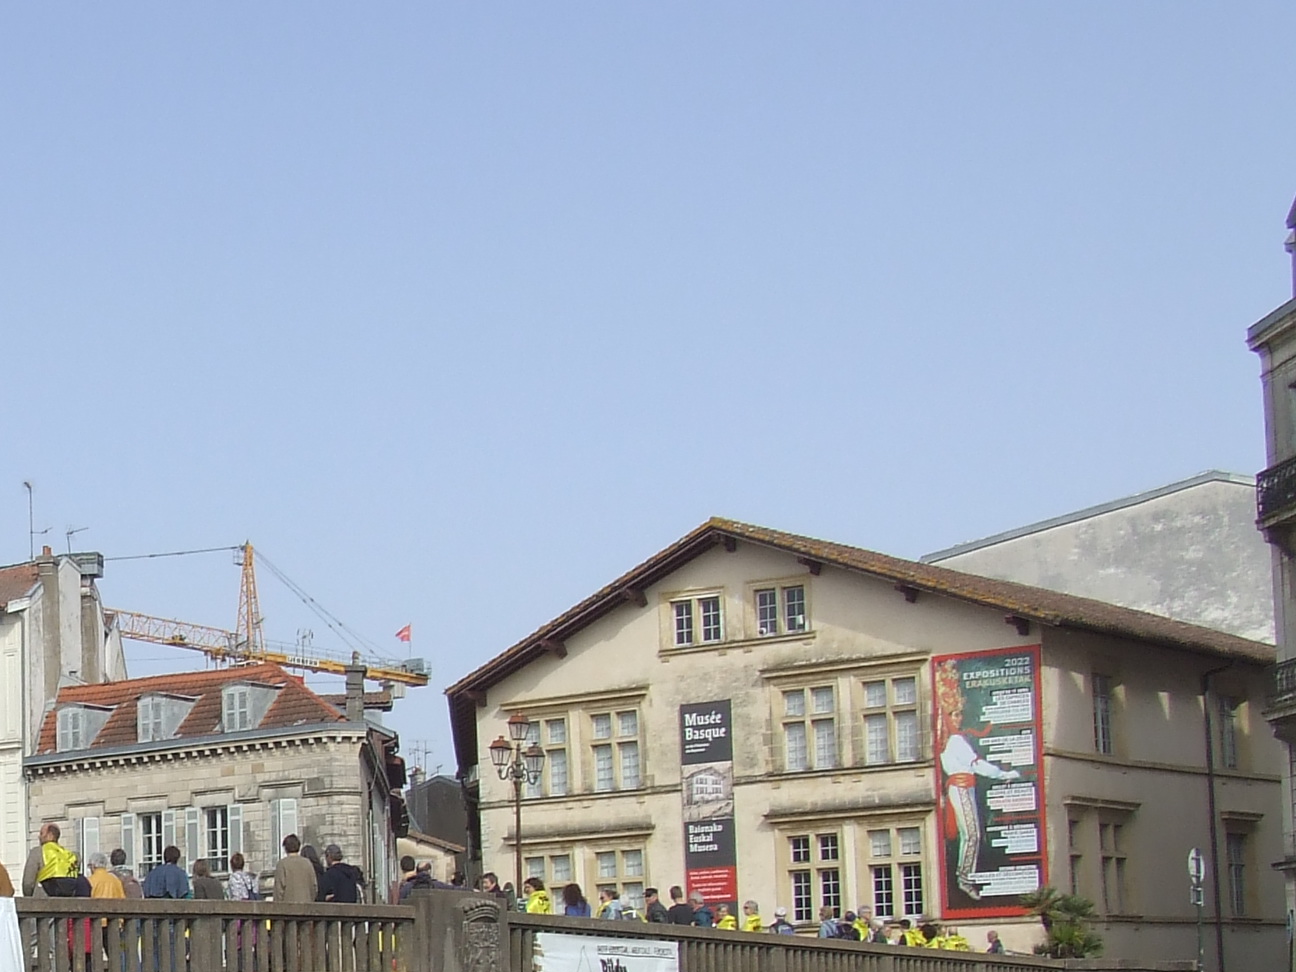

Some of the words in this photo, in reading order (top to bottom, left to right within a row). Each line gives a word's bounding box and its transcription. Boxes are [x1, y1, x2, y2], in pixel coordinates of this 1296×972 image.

[1004, 656, 1031, 668] 2022
[962, 665, 1032, 681] EXPOSITIONS
[965, 674, 1032, 689] ERAKUSKETAK
[684, 710, 722, 727] Musée
[685, 727, 726, 742] Basque
[688, 832, 714, 844] Euskal
